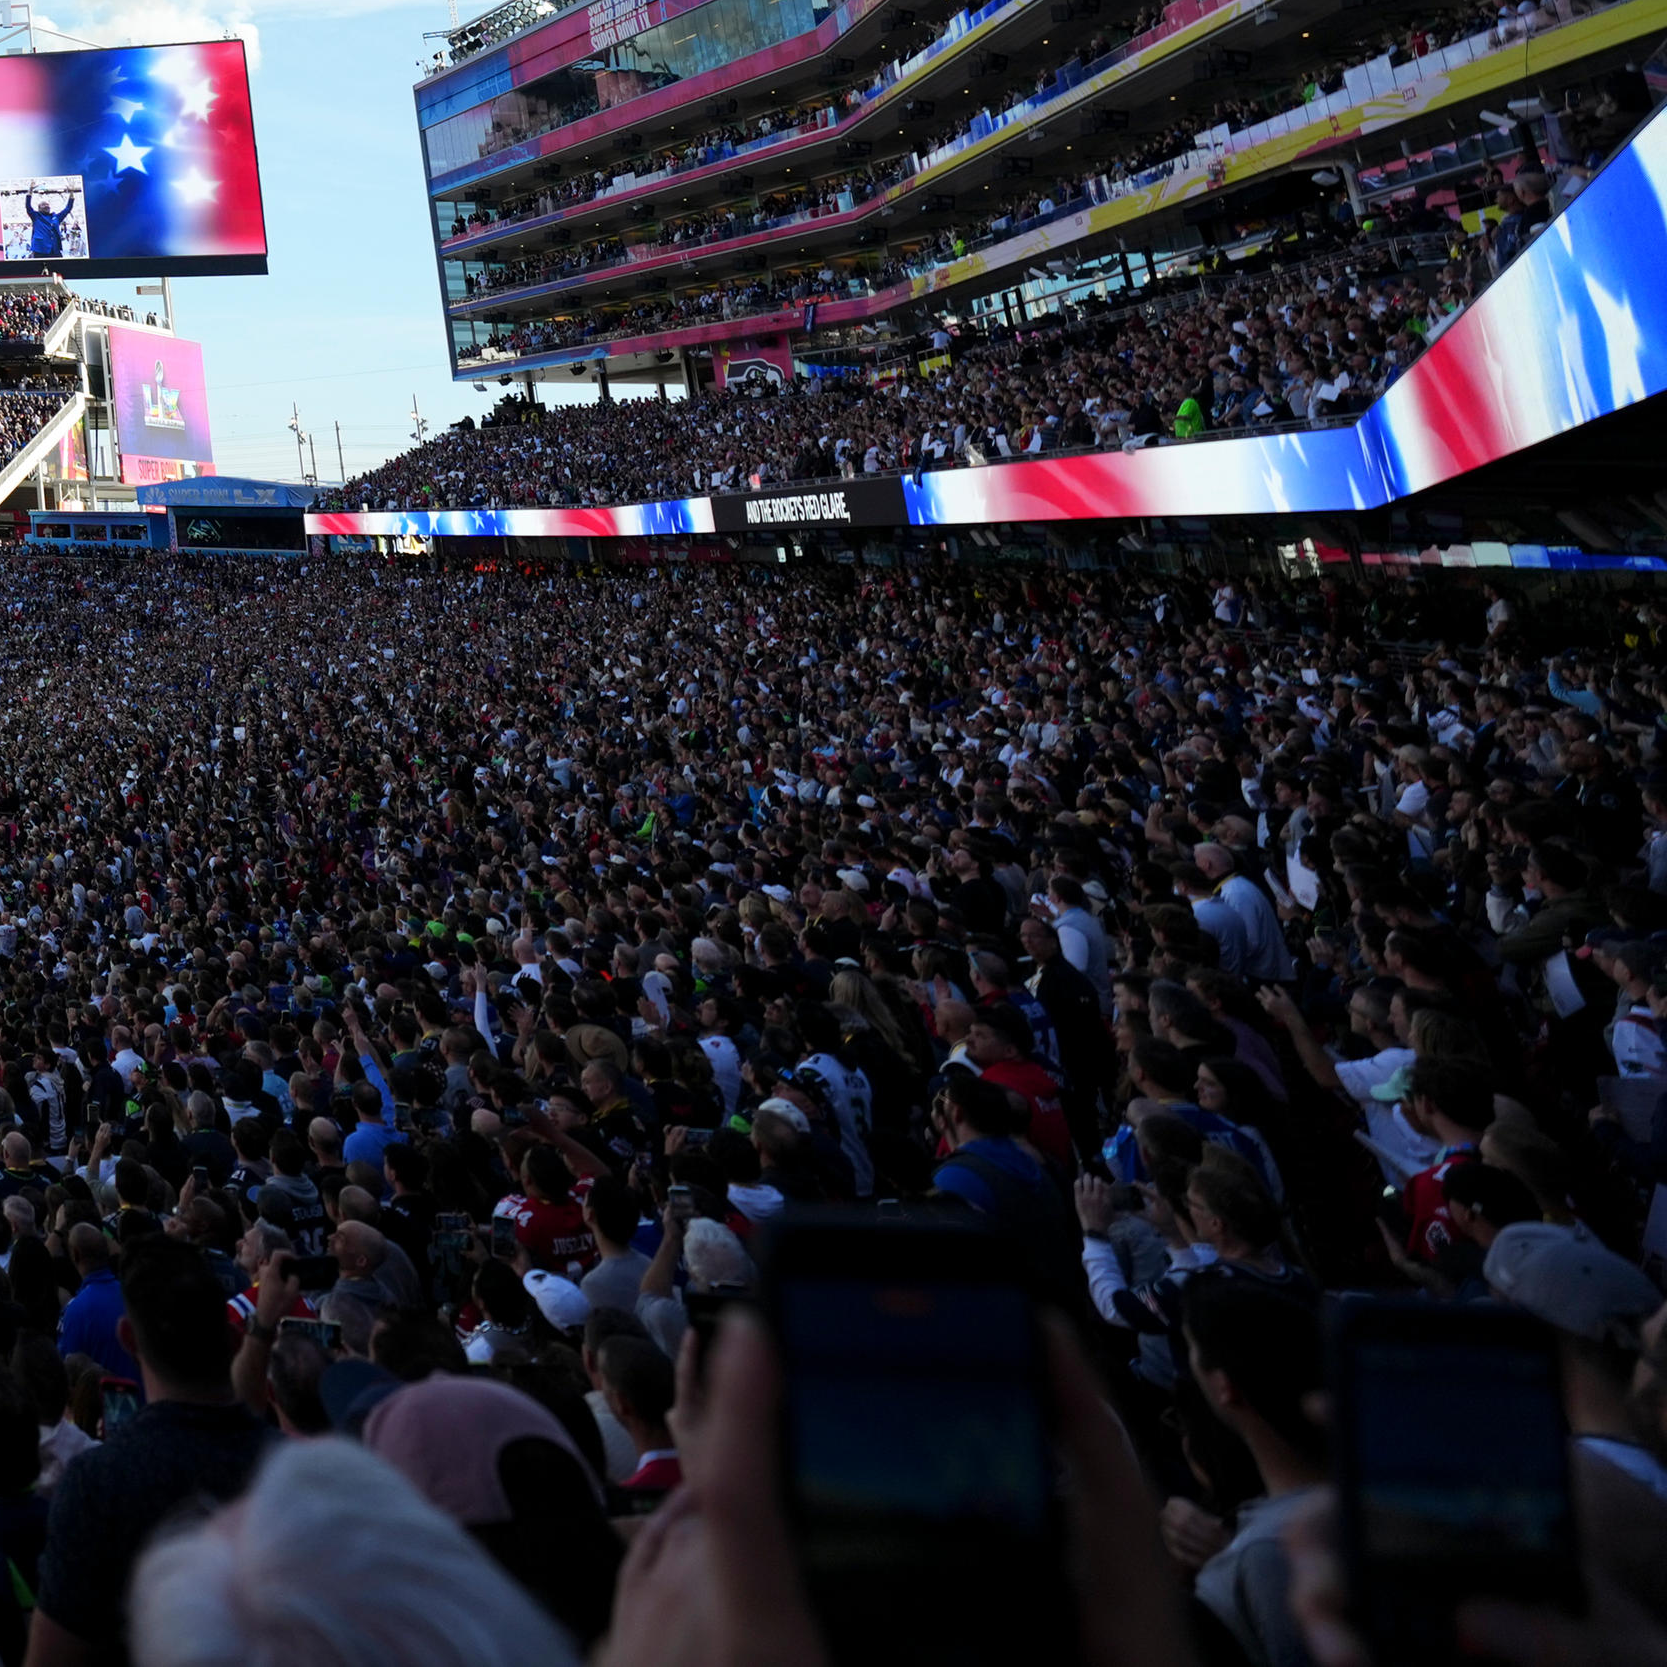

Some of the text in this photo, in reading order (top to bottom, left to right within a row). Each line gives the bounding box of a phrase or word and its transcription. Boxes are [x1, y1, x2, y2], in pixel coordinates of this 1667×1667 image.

[169, 488, 278, 505] SUPER BOWL LX
[746, 500, 760, 523] AND
[759, 499, 773, 522] THE
[804, 494, 821, 520] RED
